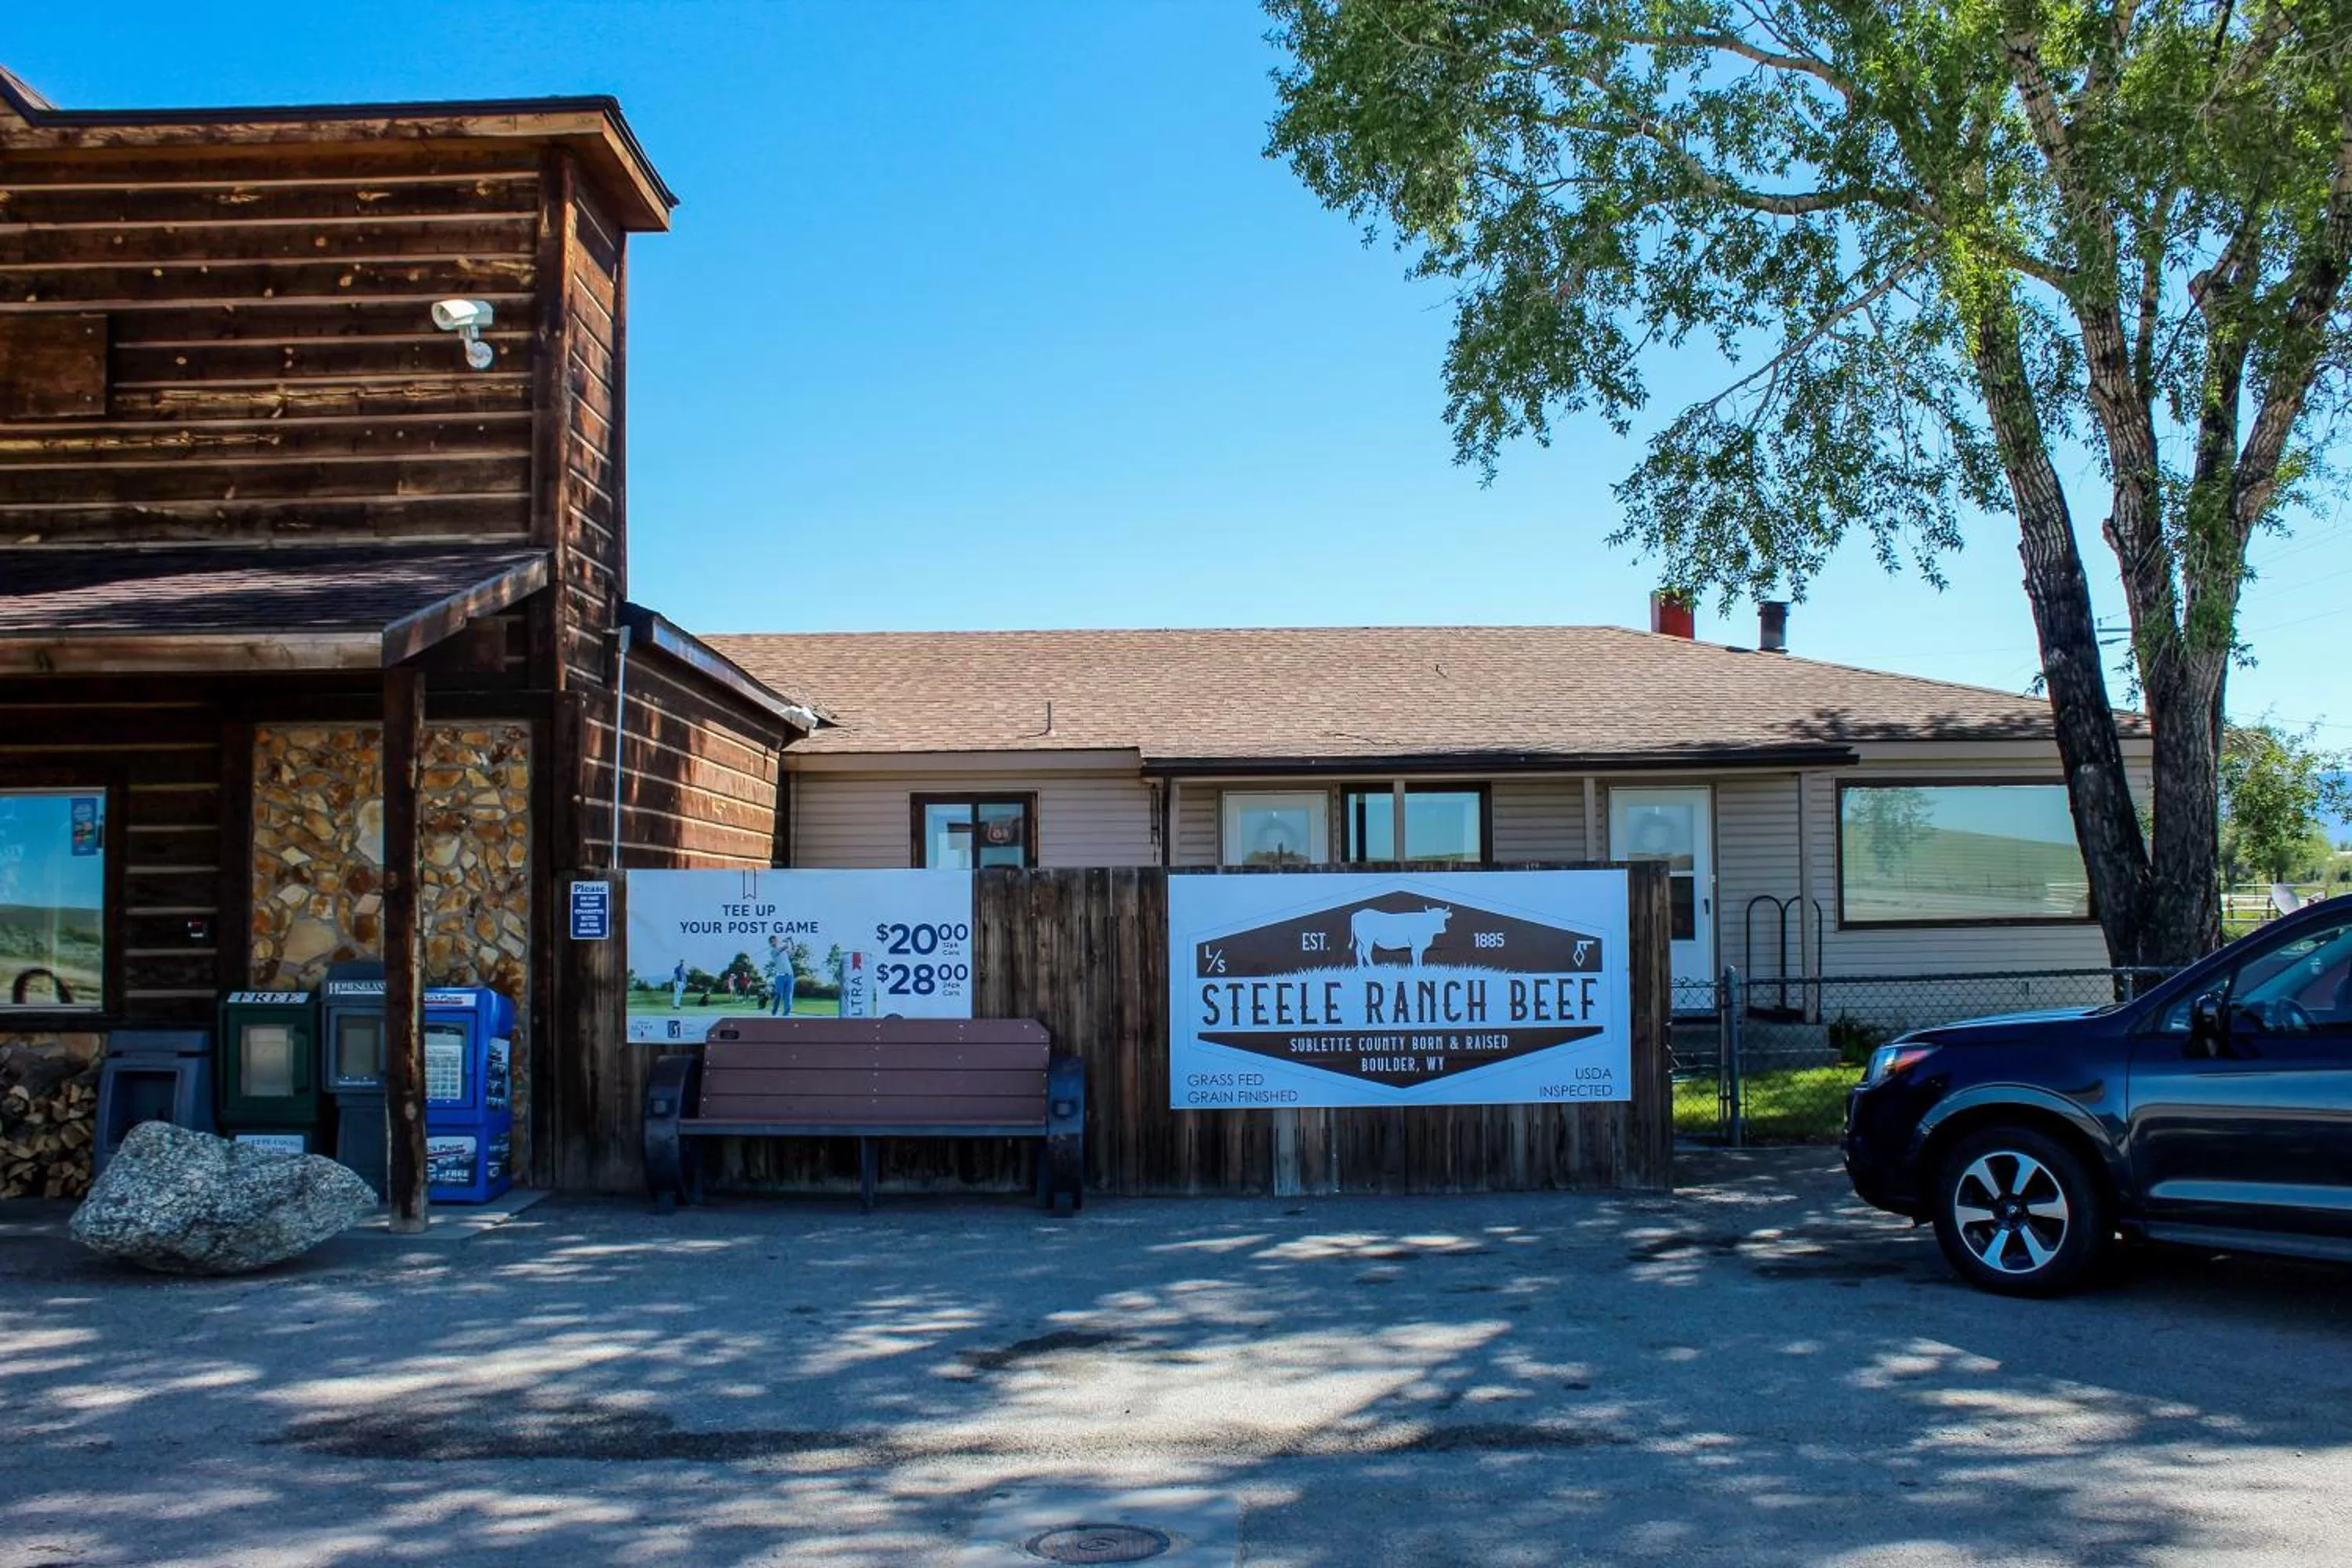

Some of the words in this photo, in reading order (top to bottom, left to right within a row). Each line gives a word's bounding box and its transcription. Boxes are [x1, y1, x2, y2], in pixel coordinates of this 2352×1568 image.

[574, 884, 606, 893] Please
[722, 904, 750, 916] TEE
[756, 904, 776, 916] UP
[680, 921, 722, 934] YOUR
[728, 921, 768, 934] POST
[773, 921, 819, 934] GAME
[1301, 932, 1330, 951] EST.
[1474, 932, 1504, 948] 1885
[238, 992, 302, 1004] FREE
[851, 975, 862, 1017] LTRA
[1202, 981, 1343, 1026] STEELE
[1365, 979, 1487, 1024] RANCH
[1509, 978, 1598, 1022] BEEF
[1289, 1037, 1352, 1052] SUBLETTE
[1359, 1036, 1406, 1051] COUNTY
[1412, 1035, 1443, 1051] BORN
[1450, 1035, 1459, 1050] &
[1465, 1034, 1509, 1050] RAISED
[1361, 1057, 1421, 1073] BOULDER,
[1427, 1056, 1445, 1071] WY
[1187, 1073, 1234, 1087] GRASS
[1238, 1073, 1265, 1086] FED
[1575, 1067, 1613, 1080] USDA
[1187, 1091, 1234, 1103] GRAIN
[1238, 1090, 1298, 1102] FINISHED
[1539, 1084, 1613, 1098] INSPECTED
